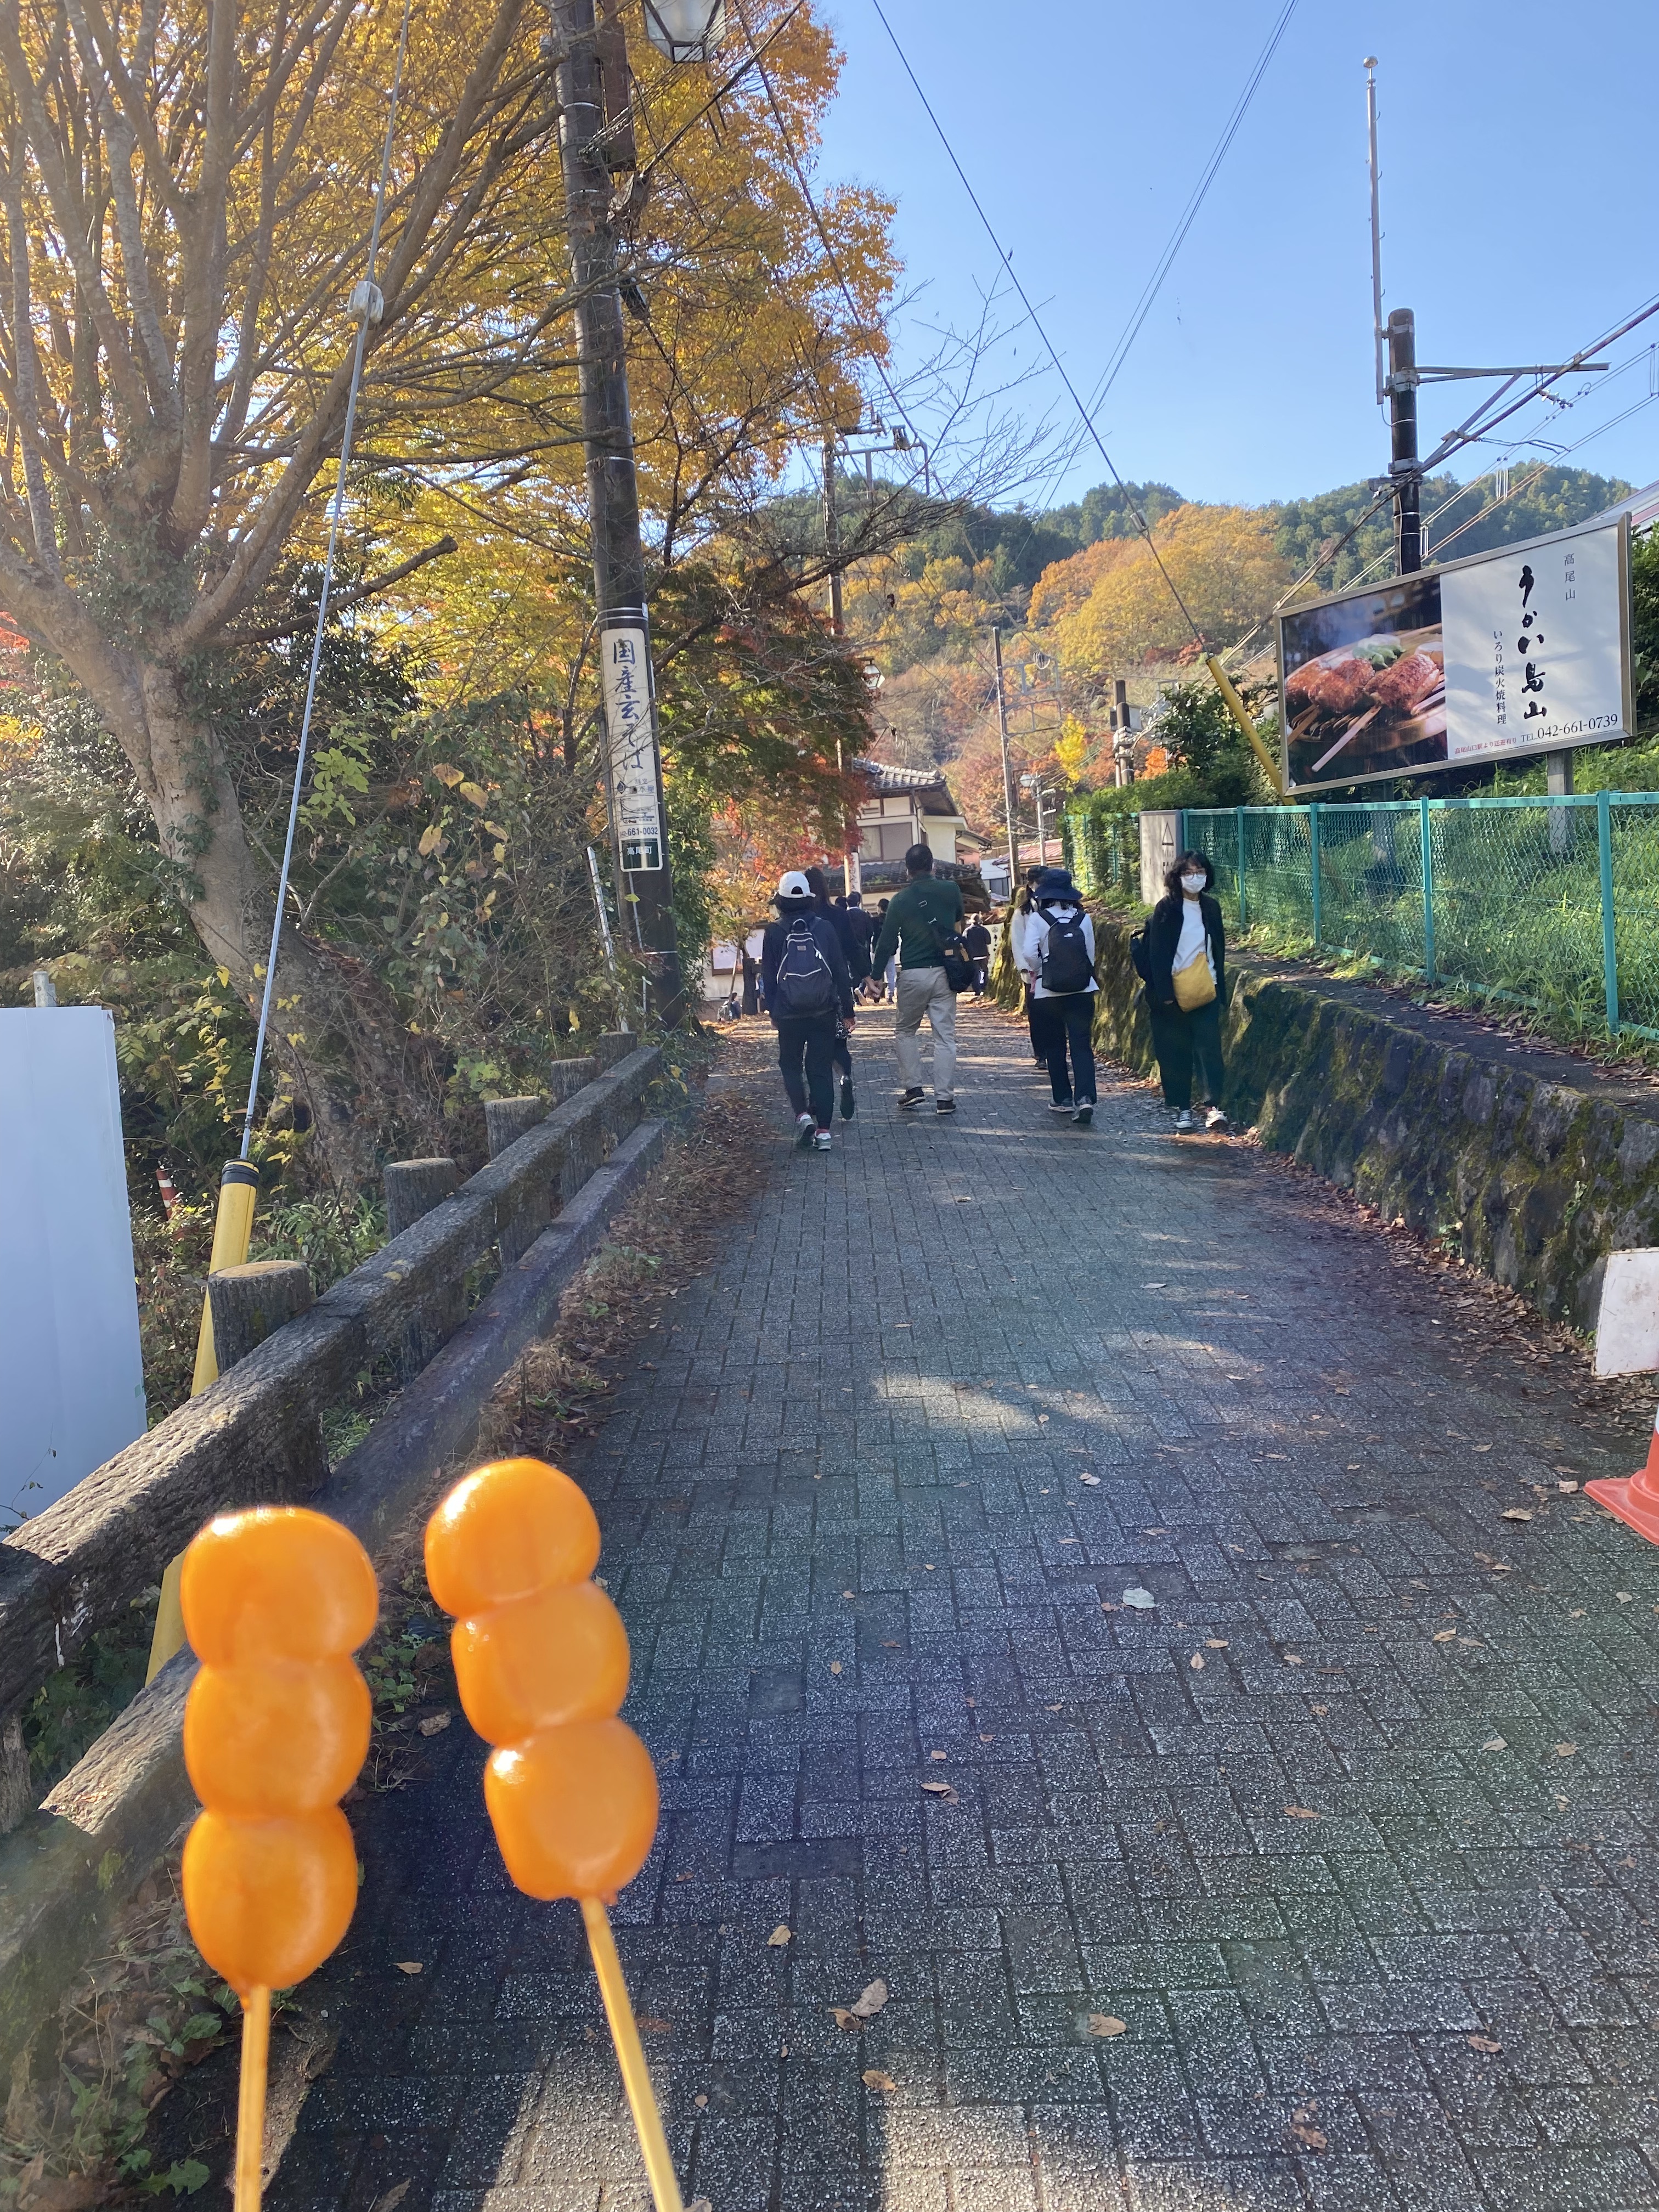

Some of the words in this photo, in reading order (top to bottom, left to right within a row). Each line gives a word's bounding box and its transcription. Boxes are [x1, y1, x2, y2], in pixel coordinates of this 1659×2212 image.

[1564, 552, 1576, 601] 高尾山
[1517, 565, 1547, 719] うかい鳥山
[1493, 630, 1506, 725] いろり炭火焼料理
[1455, 737, 1517, 755] 高尾山口駅より送迎有り
[627, 845, 652, 856] 高尾町
